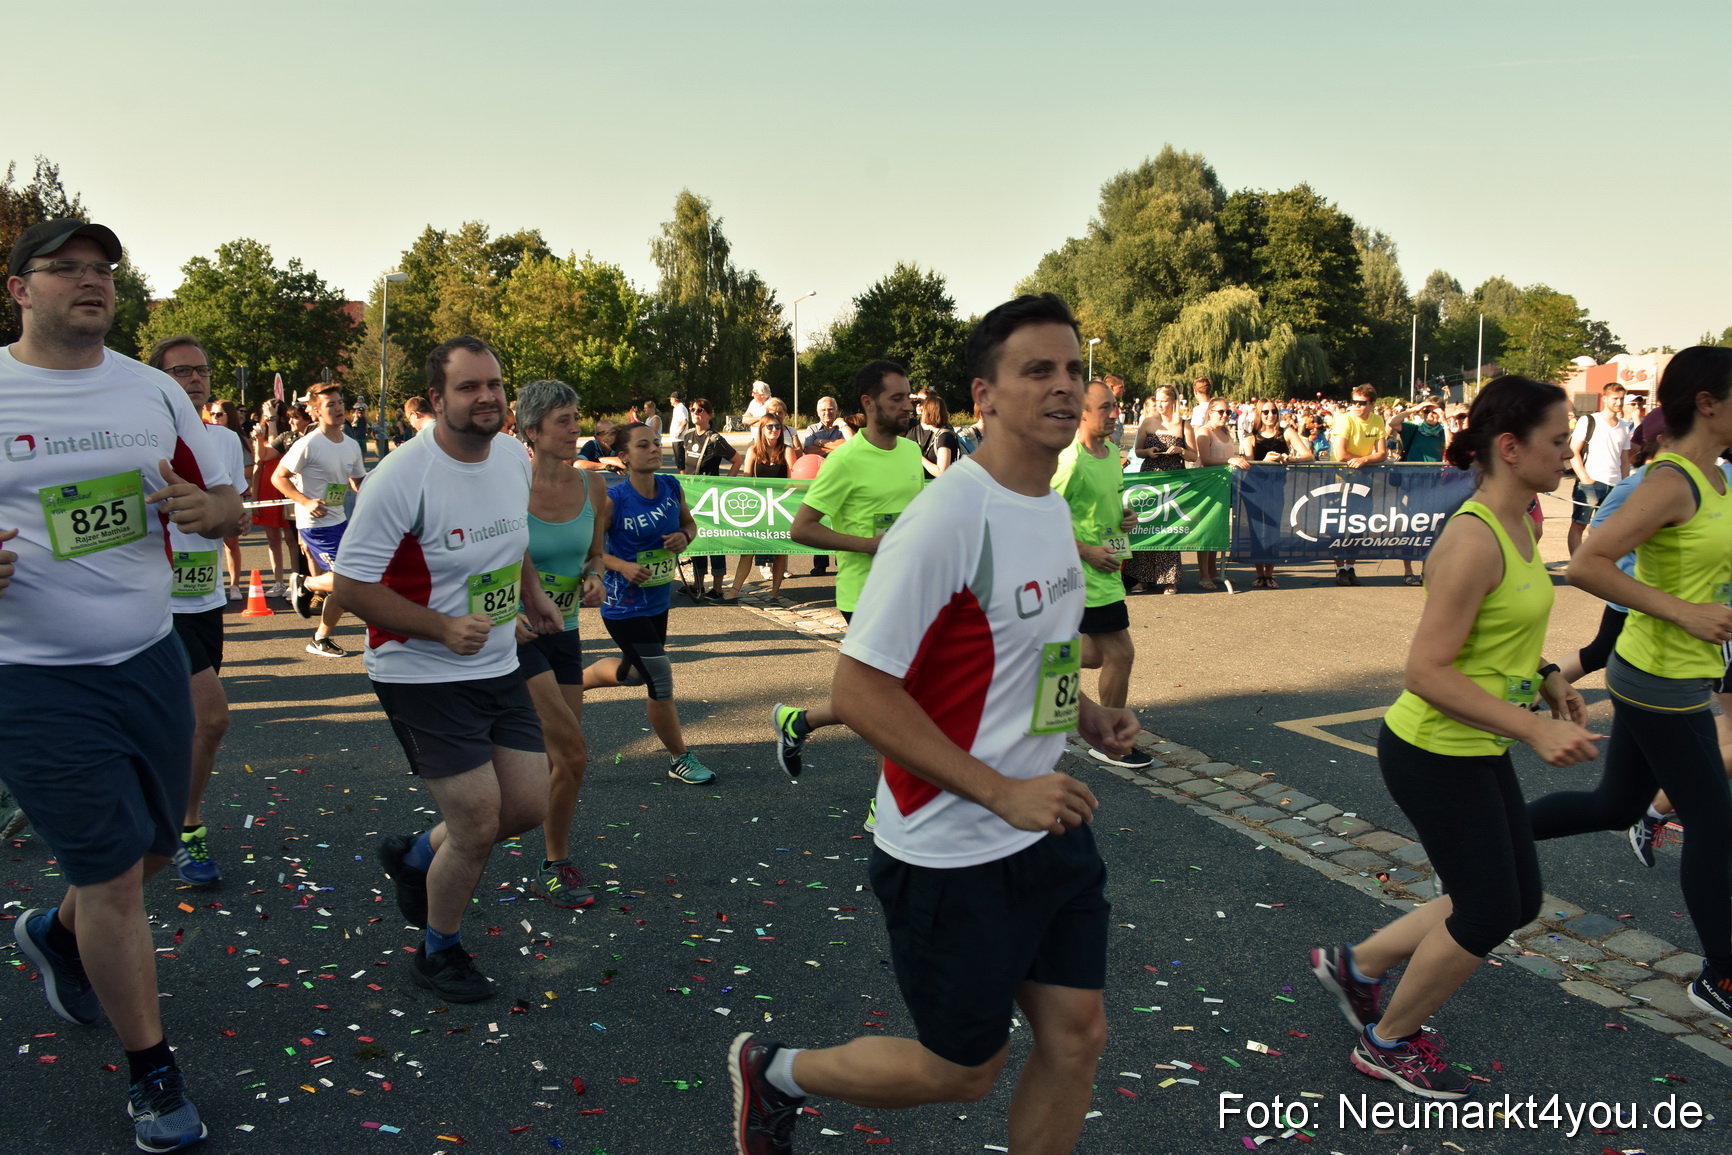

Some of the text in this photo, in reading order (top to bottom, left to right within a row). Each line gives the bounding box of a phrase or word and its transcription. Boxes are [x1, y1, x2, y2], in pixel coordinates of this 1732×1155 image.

[44, 429, 159, 456] intellitools
[71, 500, 128, 535] 825
[690, 486, 797, 528] AOK
[1319, 506, 1446, 534] Fischer
[75, 526, 131, 544] Rajzer Matthias
[697, 527, 792, 540] Gesundheitskass
[1108, 537, 1126, 550] 332
[1328, 536, 1434, 549] AUTOMOBILE
[174, 566, 214, 584] 1452
[484, 584, 515, 612] 824
